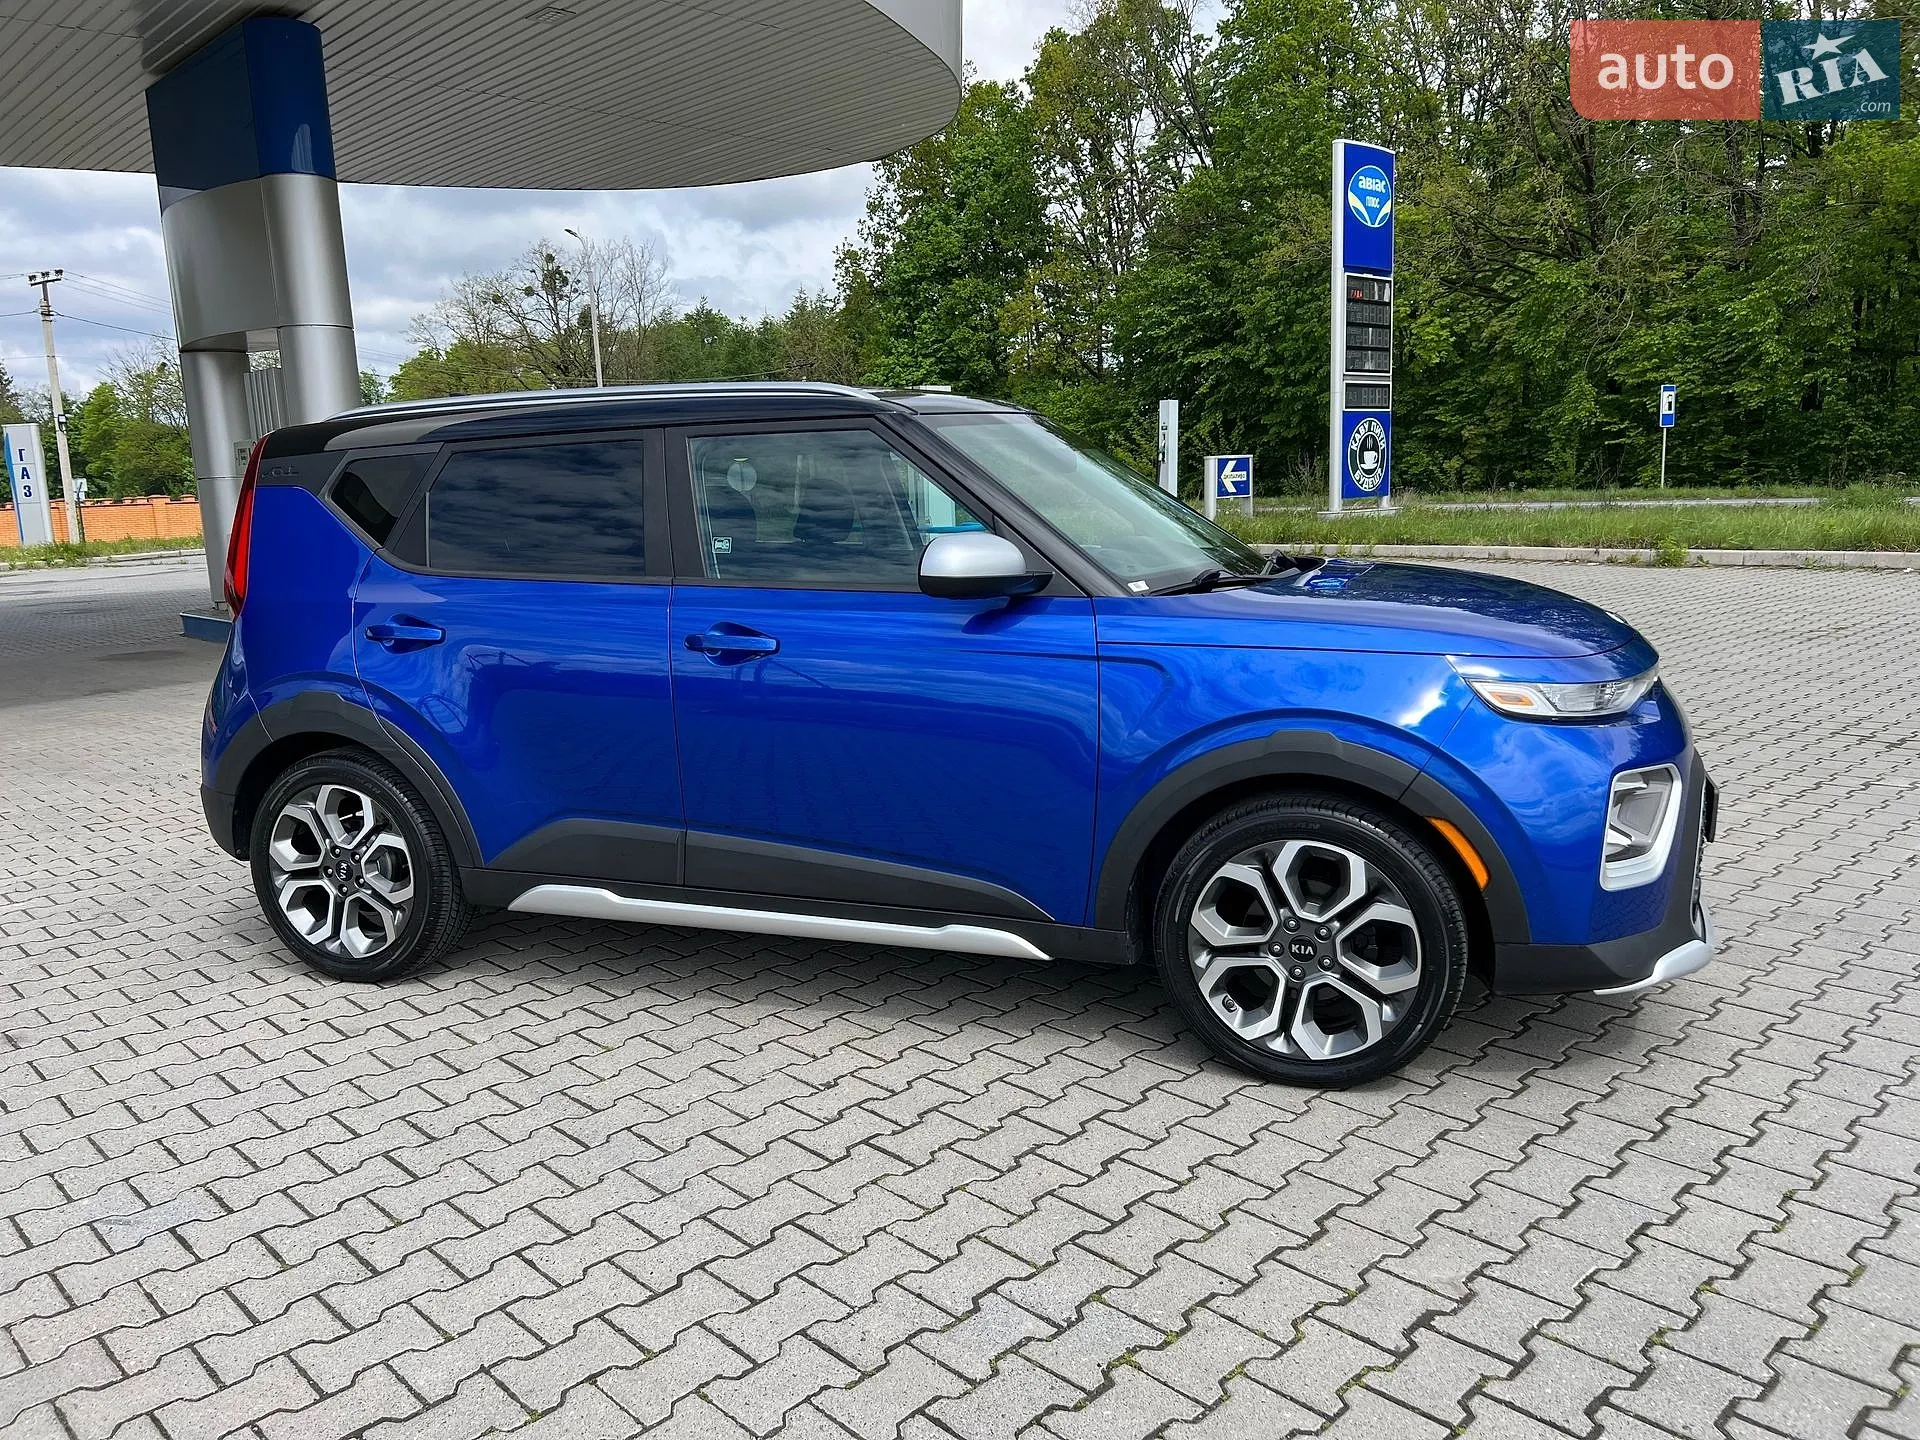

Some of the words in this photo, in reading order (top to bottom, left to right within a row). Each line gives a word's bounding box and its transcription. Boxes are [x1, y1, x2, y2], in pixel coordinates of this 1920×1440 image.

[1351, 421, 1369, 451] КАВУ
[1371, 421, 1386, 450] ПИТИ
[18, 448, 32, 498] ГАЗ
[1291, 944, 1314, 955] KIA
